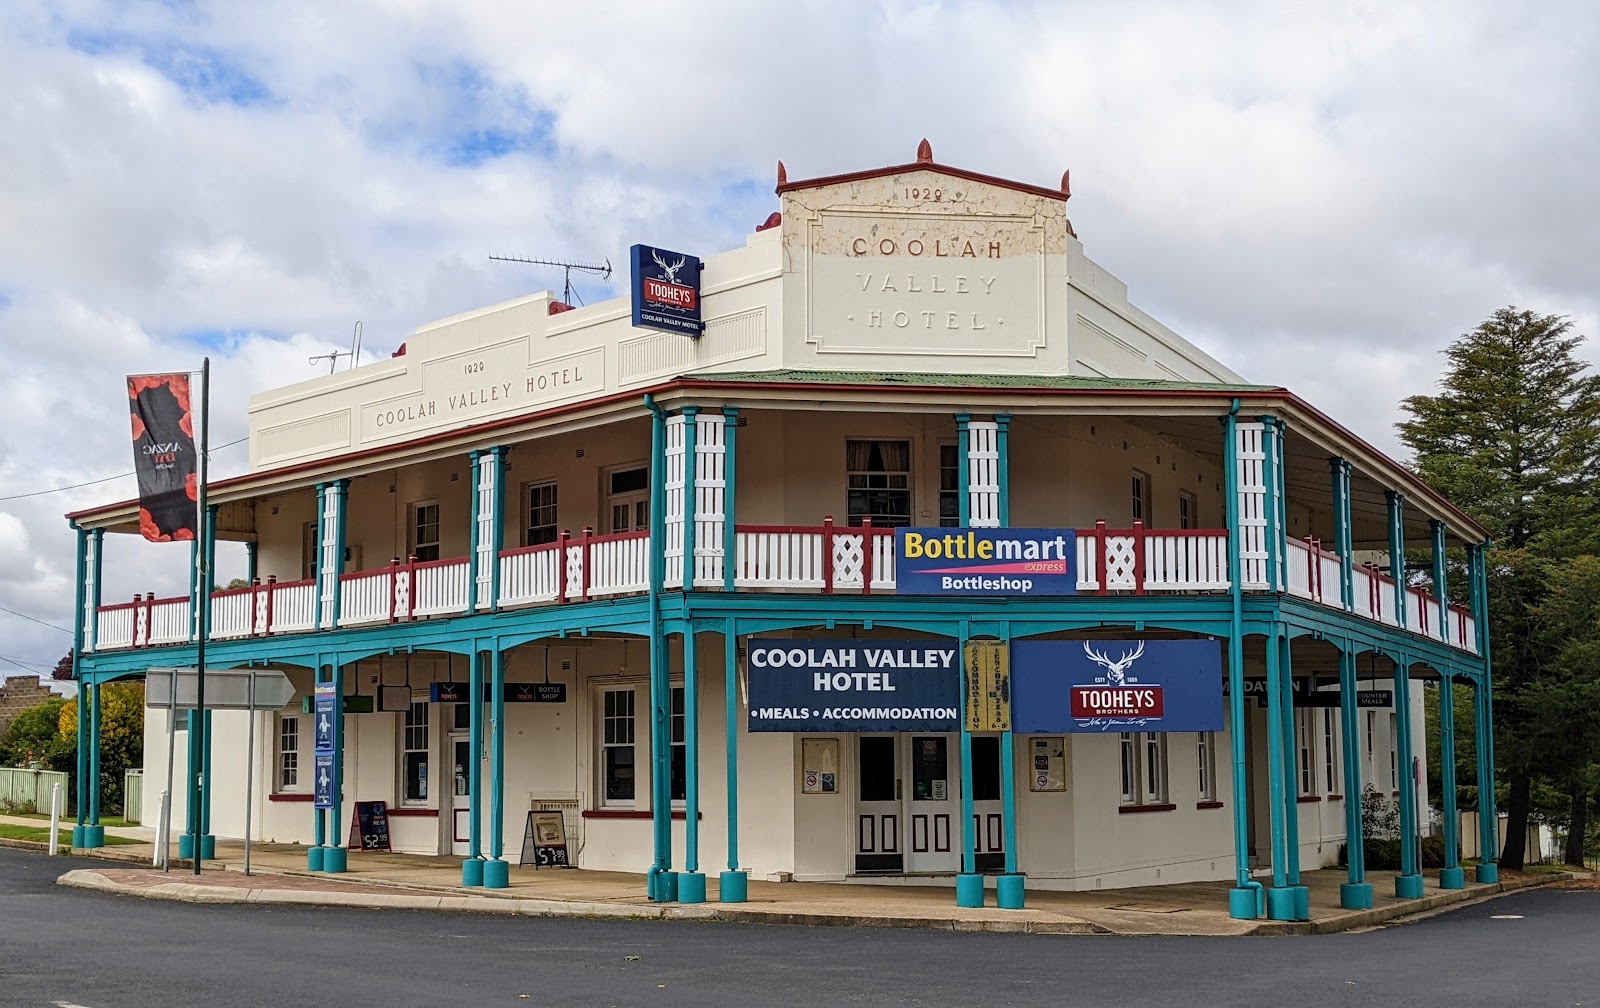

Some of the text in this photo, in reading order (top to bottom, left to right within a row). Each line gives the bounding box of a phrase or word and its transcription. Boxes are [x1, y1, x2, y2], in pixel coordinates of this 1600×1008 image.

[852, 237, 1001, 259] COOLAH
[649, 283, 690, 303] TOOHEYS
[856, 273, 996, 294] VALLEY
[641, 314, 662, 322] COOLAH
[663, 318, 681, 326] VALLEY
[868, 310, 985, 330] HOTEL
[376, 366, 583, 427] COOLAH VALLEY HOTEL
[904, 531, 1067, 560] Bottlemart
[1024, 561, 1064, 573] express
[942, 576, 1033, 593] Bottleshop
[751, 648, 956, 668] COOLAH VALLEY
[813, 672, 896, 691] HOTEL
[1079, 689, 1155, 708] TOOHEYS
[759, 707, 957, 720] MEALS ACCOMMODATION
